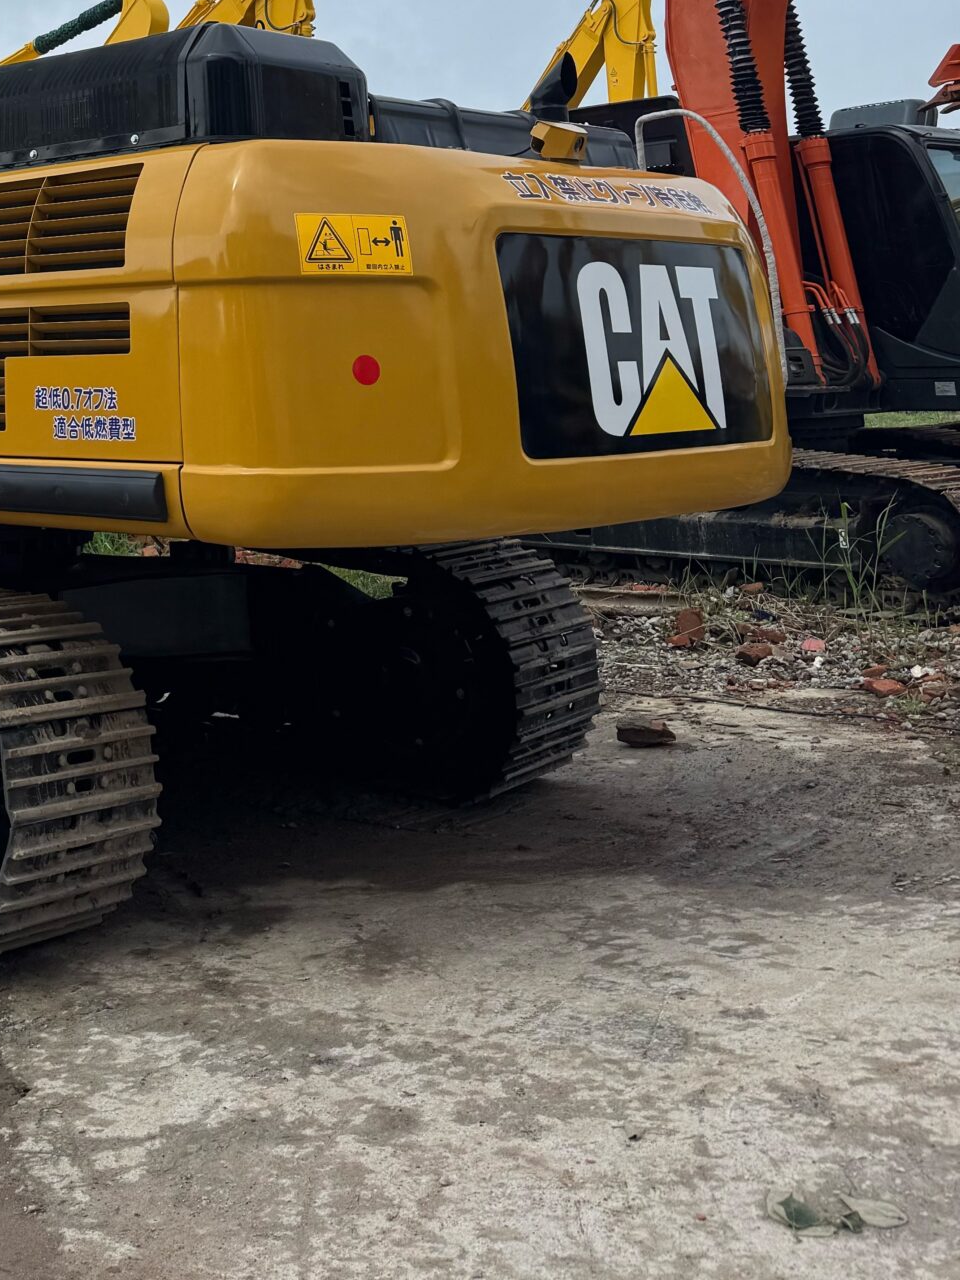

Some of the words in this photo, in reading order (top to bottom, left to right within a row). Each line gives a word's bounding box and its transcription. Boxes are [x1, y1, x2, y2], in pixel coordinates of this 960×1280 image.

[576, 261, 727, 437] CAT
[34, 384, 118, 411] 超低0.7オフ法
[53, 414, 136, 441] 適合低燃費型
